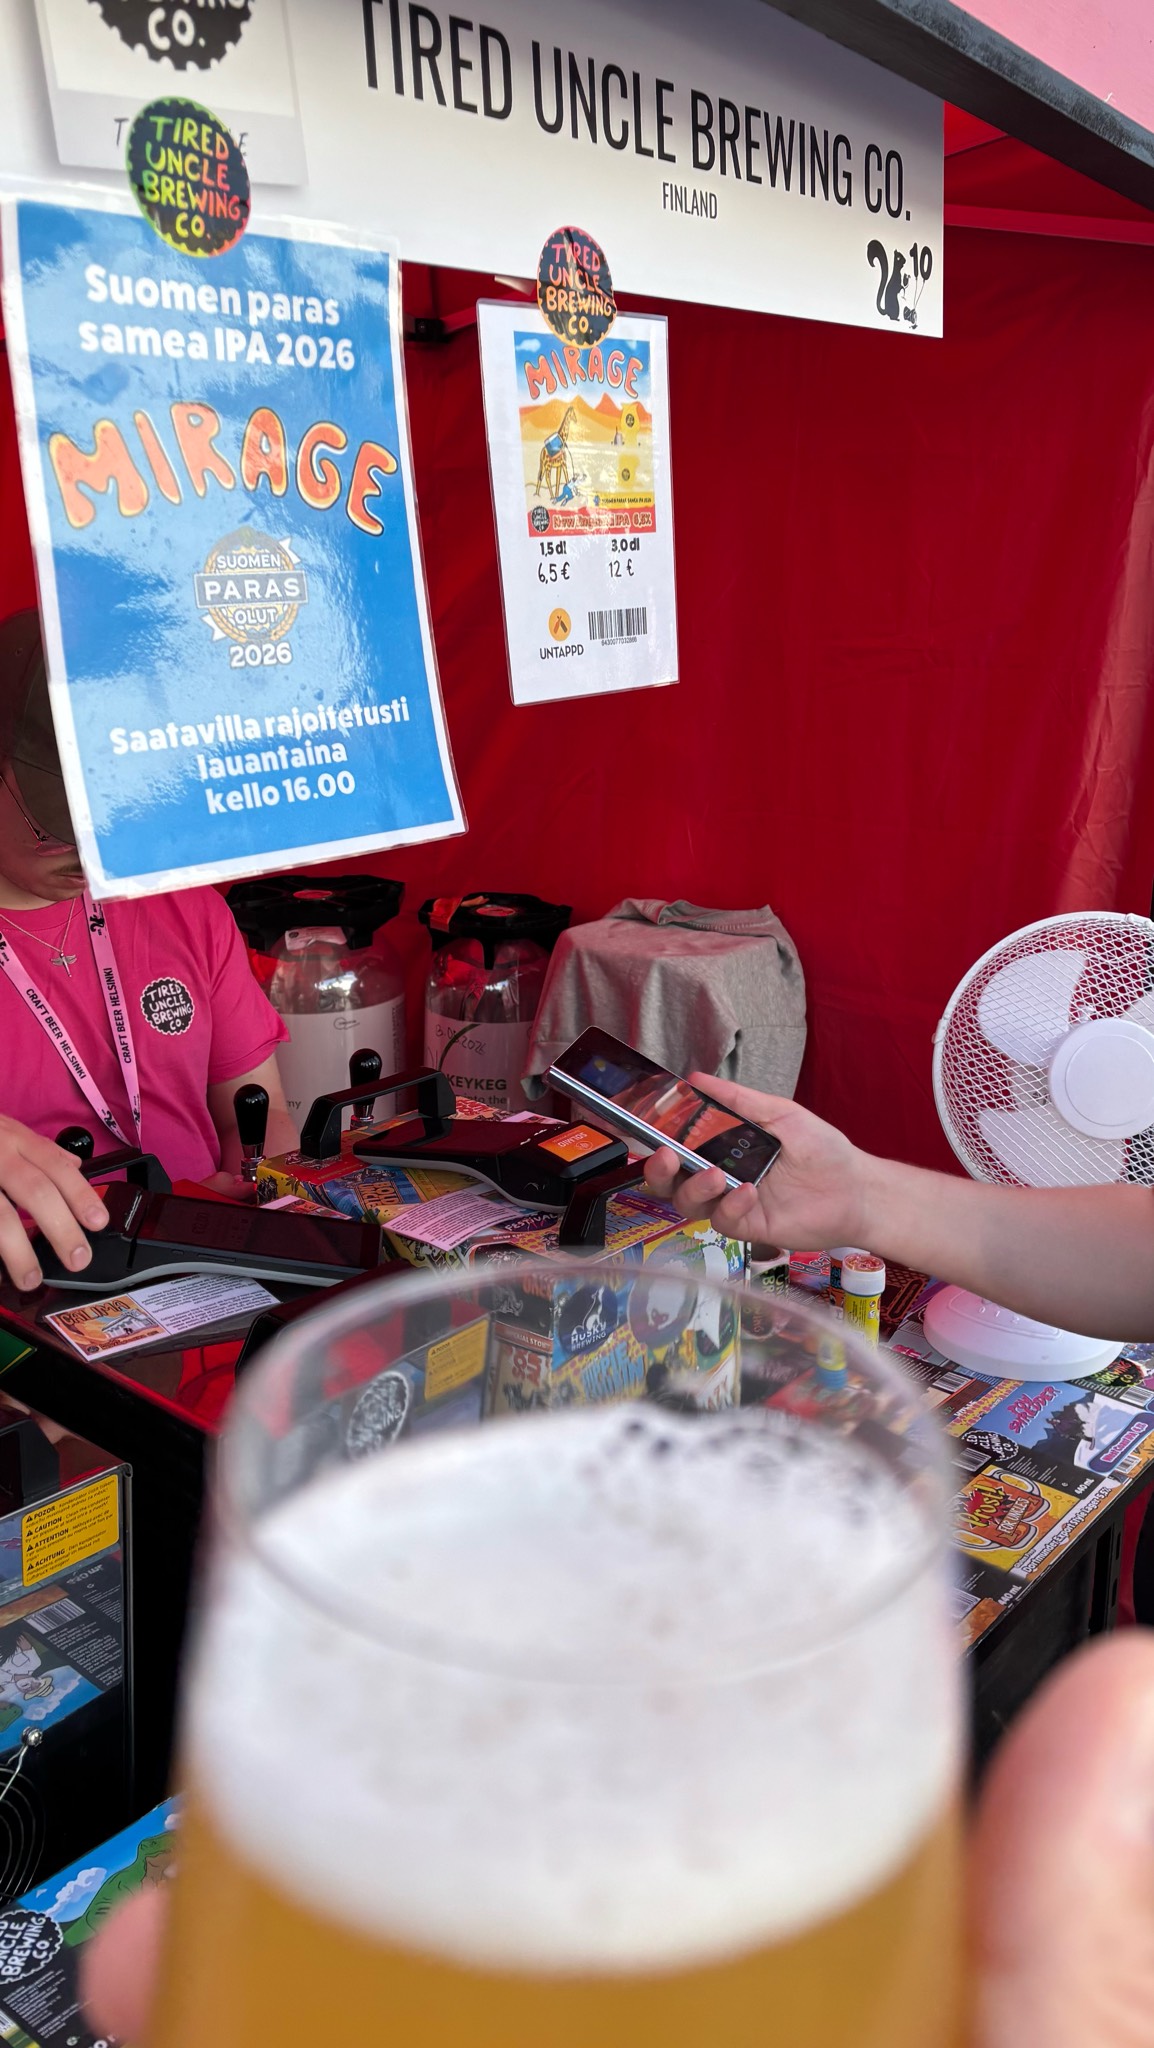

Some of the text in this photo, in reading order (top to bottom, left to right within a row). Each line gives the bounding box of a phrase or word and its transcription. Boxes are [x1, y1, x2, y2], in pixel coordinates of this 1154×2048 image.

[148, 7, 205, 50] CO.
[362, 0, 911, 222] TIRED UNCLE BREWING CO.
[150, 116, 229, 160] TIRED
[146, 142, 229, 191] UNCLE
[142, 170, 240, 220] BREWING
[662, 181, 718, 219] FINLAND
[175, 212, 212, 239] CO.
[552, 243, 600, 271] TIRED
[549, 264, 603, 294] UNCLE
[85, 264, 340, 326] Suomen paras
[545, 286, 612, 316] BREWING
[79, 321, 355, 371] samea IPA 2026
[524, 345, 643, 400] MIRAGE
[49, 401, 398, 536] MIRAGE
[540, 541, 567, 557] 1,5 dl
[611, 537, 640, 553] 3,0 dl
[216, 553, 282, 570] SUOMEN
[538, 562, 570, 584] 6,5 €
[609, 559, 634, 577] 12 €
[203, 577, 301, 603] PARAS
[233, 607, 278, 626] OLUT
[229, 642, 293, 669] 2026
[540, 644, 584, 660] UNTAPPD
[109, 697, 411, 755] Saatavilla rajoitetusti
[198, 739, 348, 783] lauantaina
[206, 770, 356, 815] kello 16.00
[147, 983, 182, 1002] TIRED
[149, 994, 185, 1013] UNCLE
[103, 967, 131, 1063] CRAFT BEER HELSINKI
[152, 1005, 192, 1025] BREWING
[169, 1019, 184, 1032] CO.
[26, 988, 86, 1079] CRAFT BEER HELSINKI
[446, 1074, 507, 1090] KEYKEG
[505, 1212, 558, 1231] FESTIVAL
[60, 1300, 130, 1325] CALIMA
[571, 1322, 606, 1344] HUSKY
[34, 1517, 61, 1532] CAUTION
[34, 1529, 68, 1547] ATTENTION
[35, 1549, 64, 1566] ACHTUNG
[1, 1916, 46, 1976] BREWING
